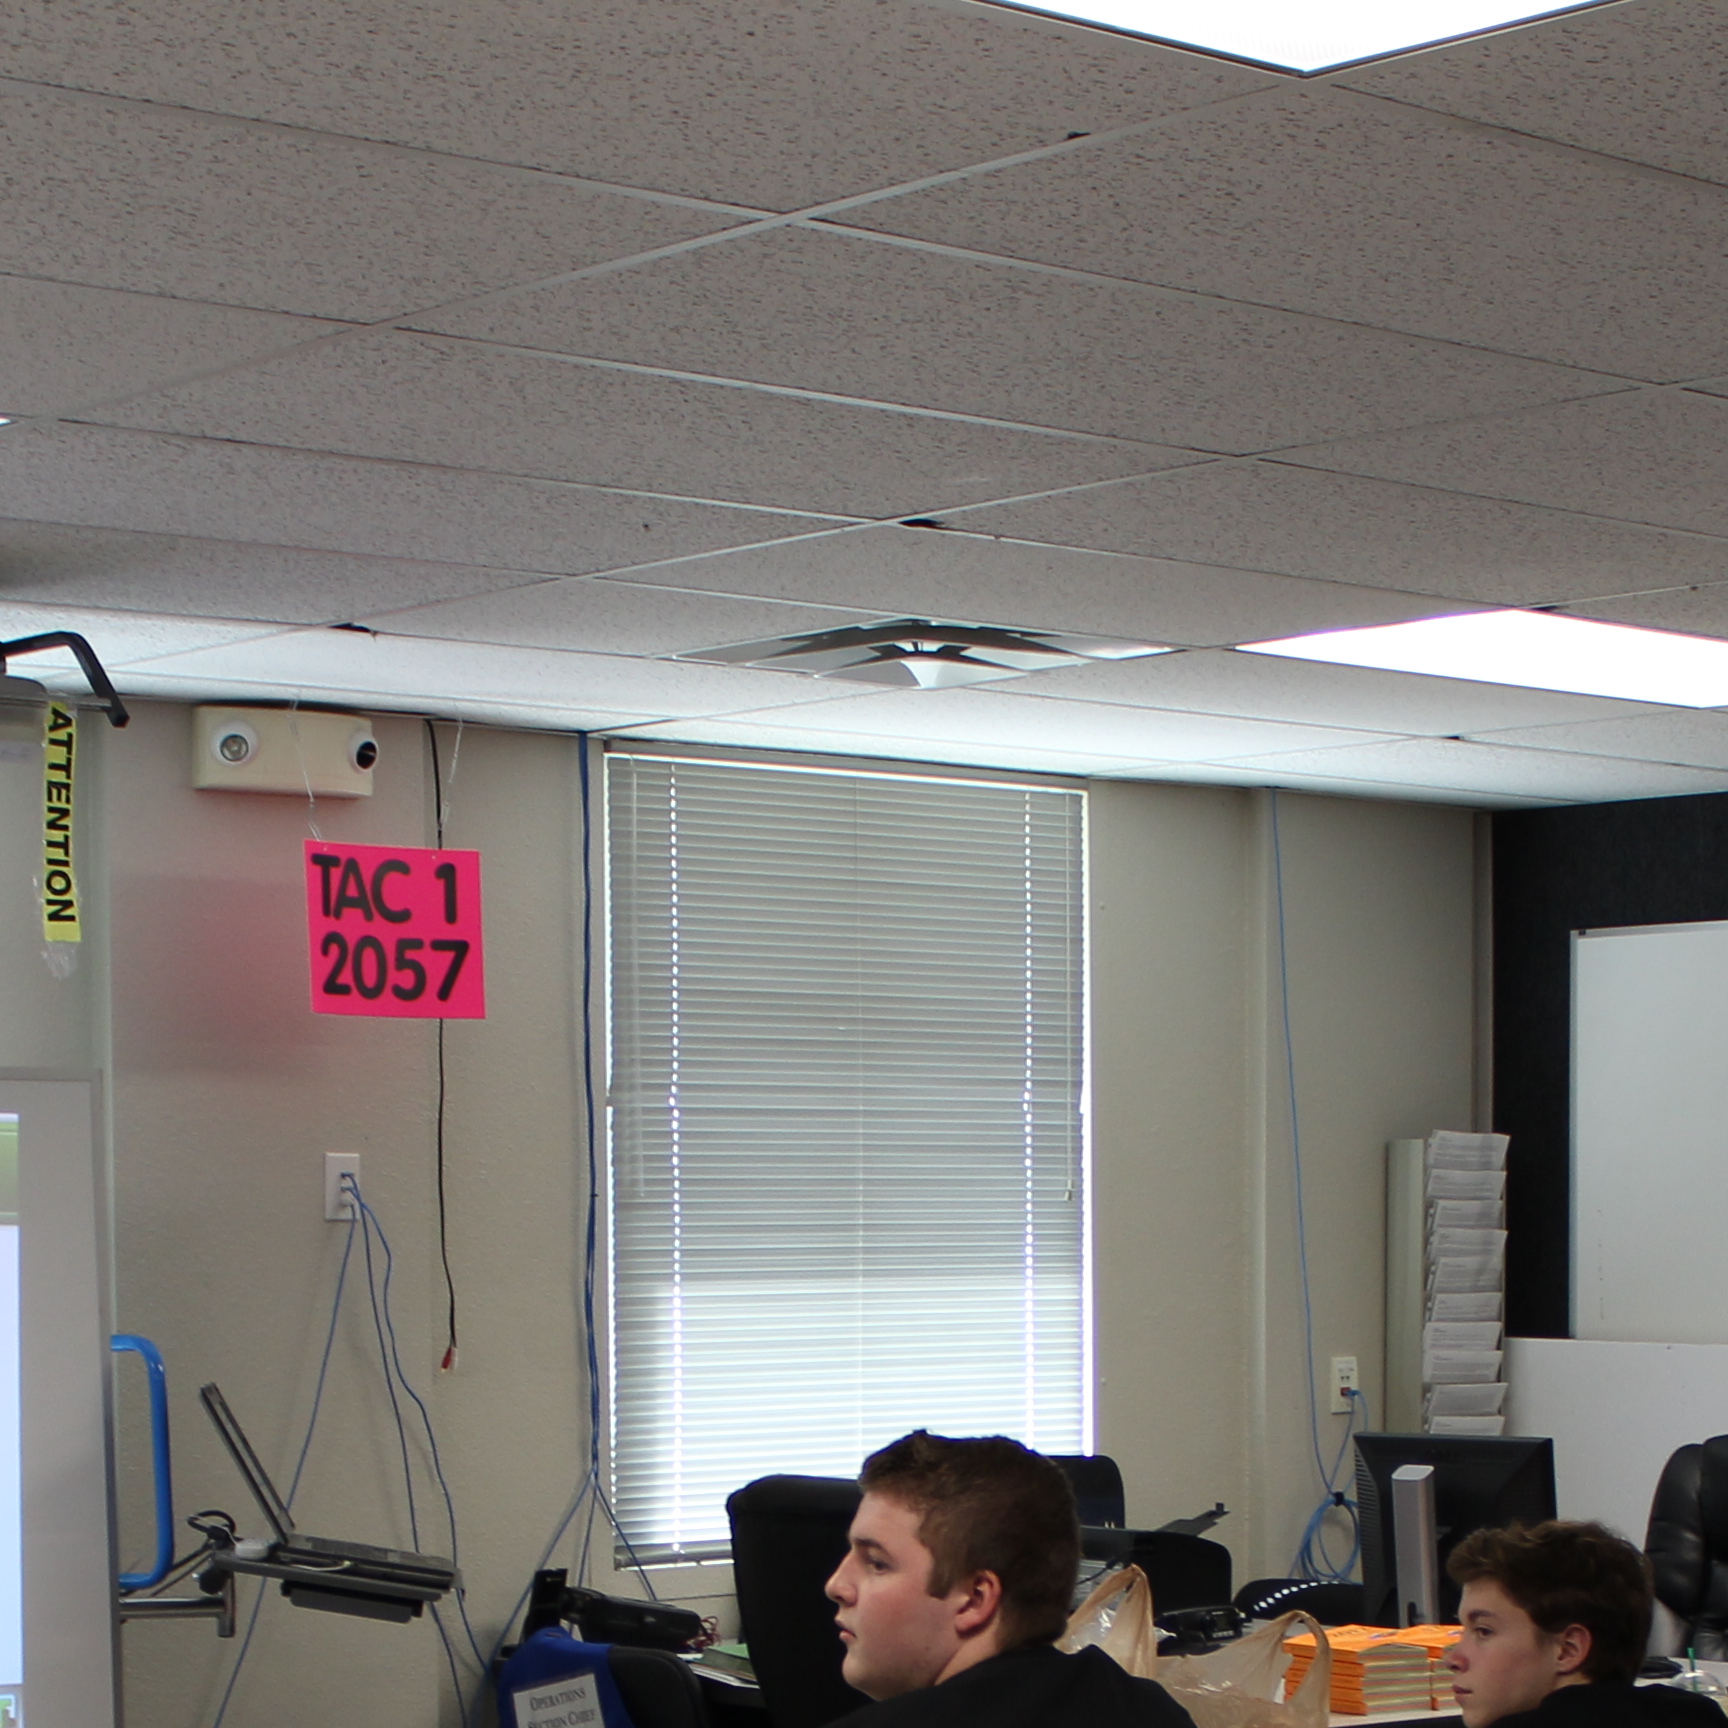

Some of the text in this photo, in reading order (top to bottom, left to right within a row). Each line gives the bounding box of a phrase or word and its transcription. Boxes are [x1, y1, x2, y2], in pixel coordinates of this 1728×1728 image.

[44, 706, 77, 923] ATTENTION
[311, 853, 458, 925] TAC 1
[320, 930, 470, 1003] 2057
[529, 1686, 587, 1712] OPERATIONS
[567, 1707, 596, 1727] CHIEF
